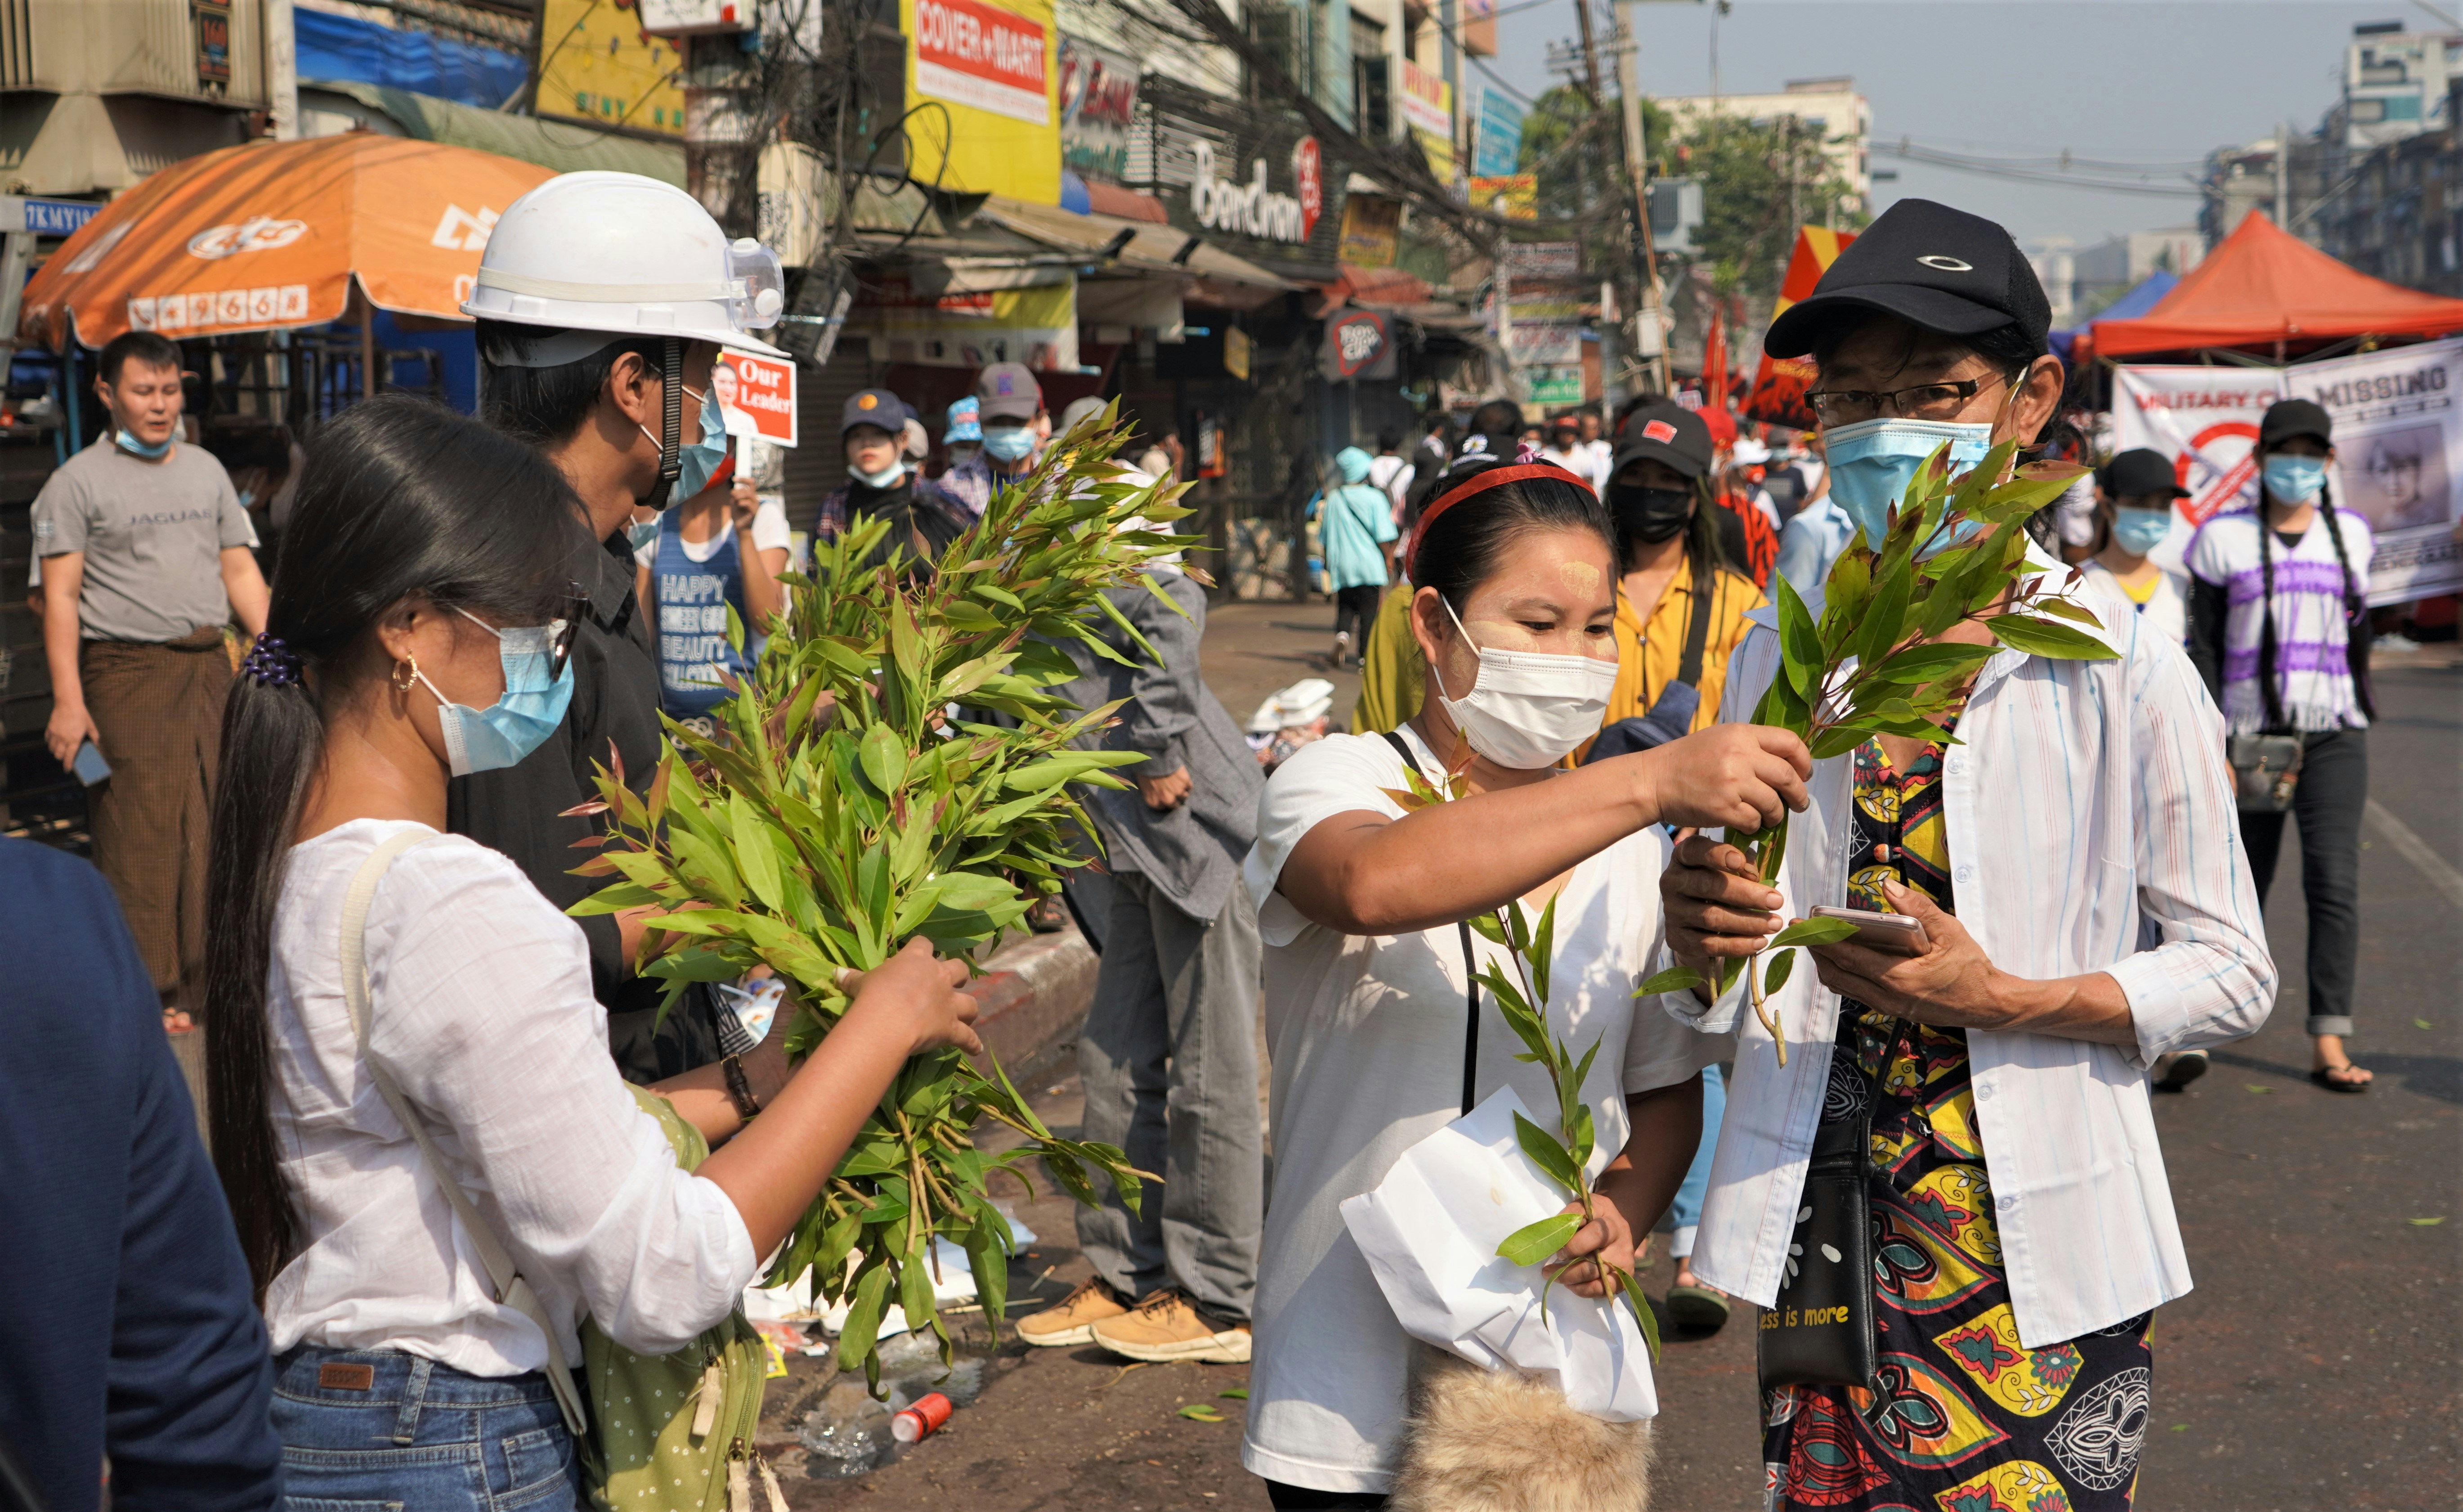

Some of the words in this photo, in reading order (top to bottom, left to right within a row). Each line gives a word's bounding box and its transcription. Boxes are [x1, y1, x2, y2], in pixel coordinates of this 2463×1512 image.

[914, 0, 982, 64] COVER
[991, 23, 1045, 82] MART
[739, 359, 783, 389] Our
[2315, 367, 2447, 407] MISSING
[740, 384, 792, 414] Leader
[2134, 389, 2248, 411] MILITARY
[131, 509, 212, 525] JAGUAR
[661, 573, 728, 604] HAPPY
[660, 635, 727, 662] BEAUTY
[1760, 1312, 1779, 1329] ess
[1785, 1305, 1798, 1327] is
[1804, 1306, 1849, 1326] more
